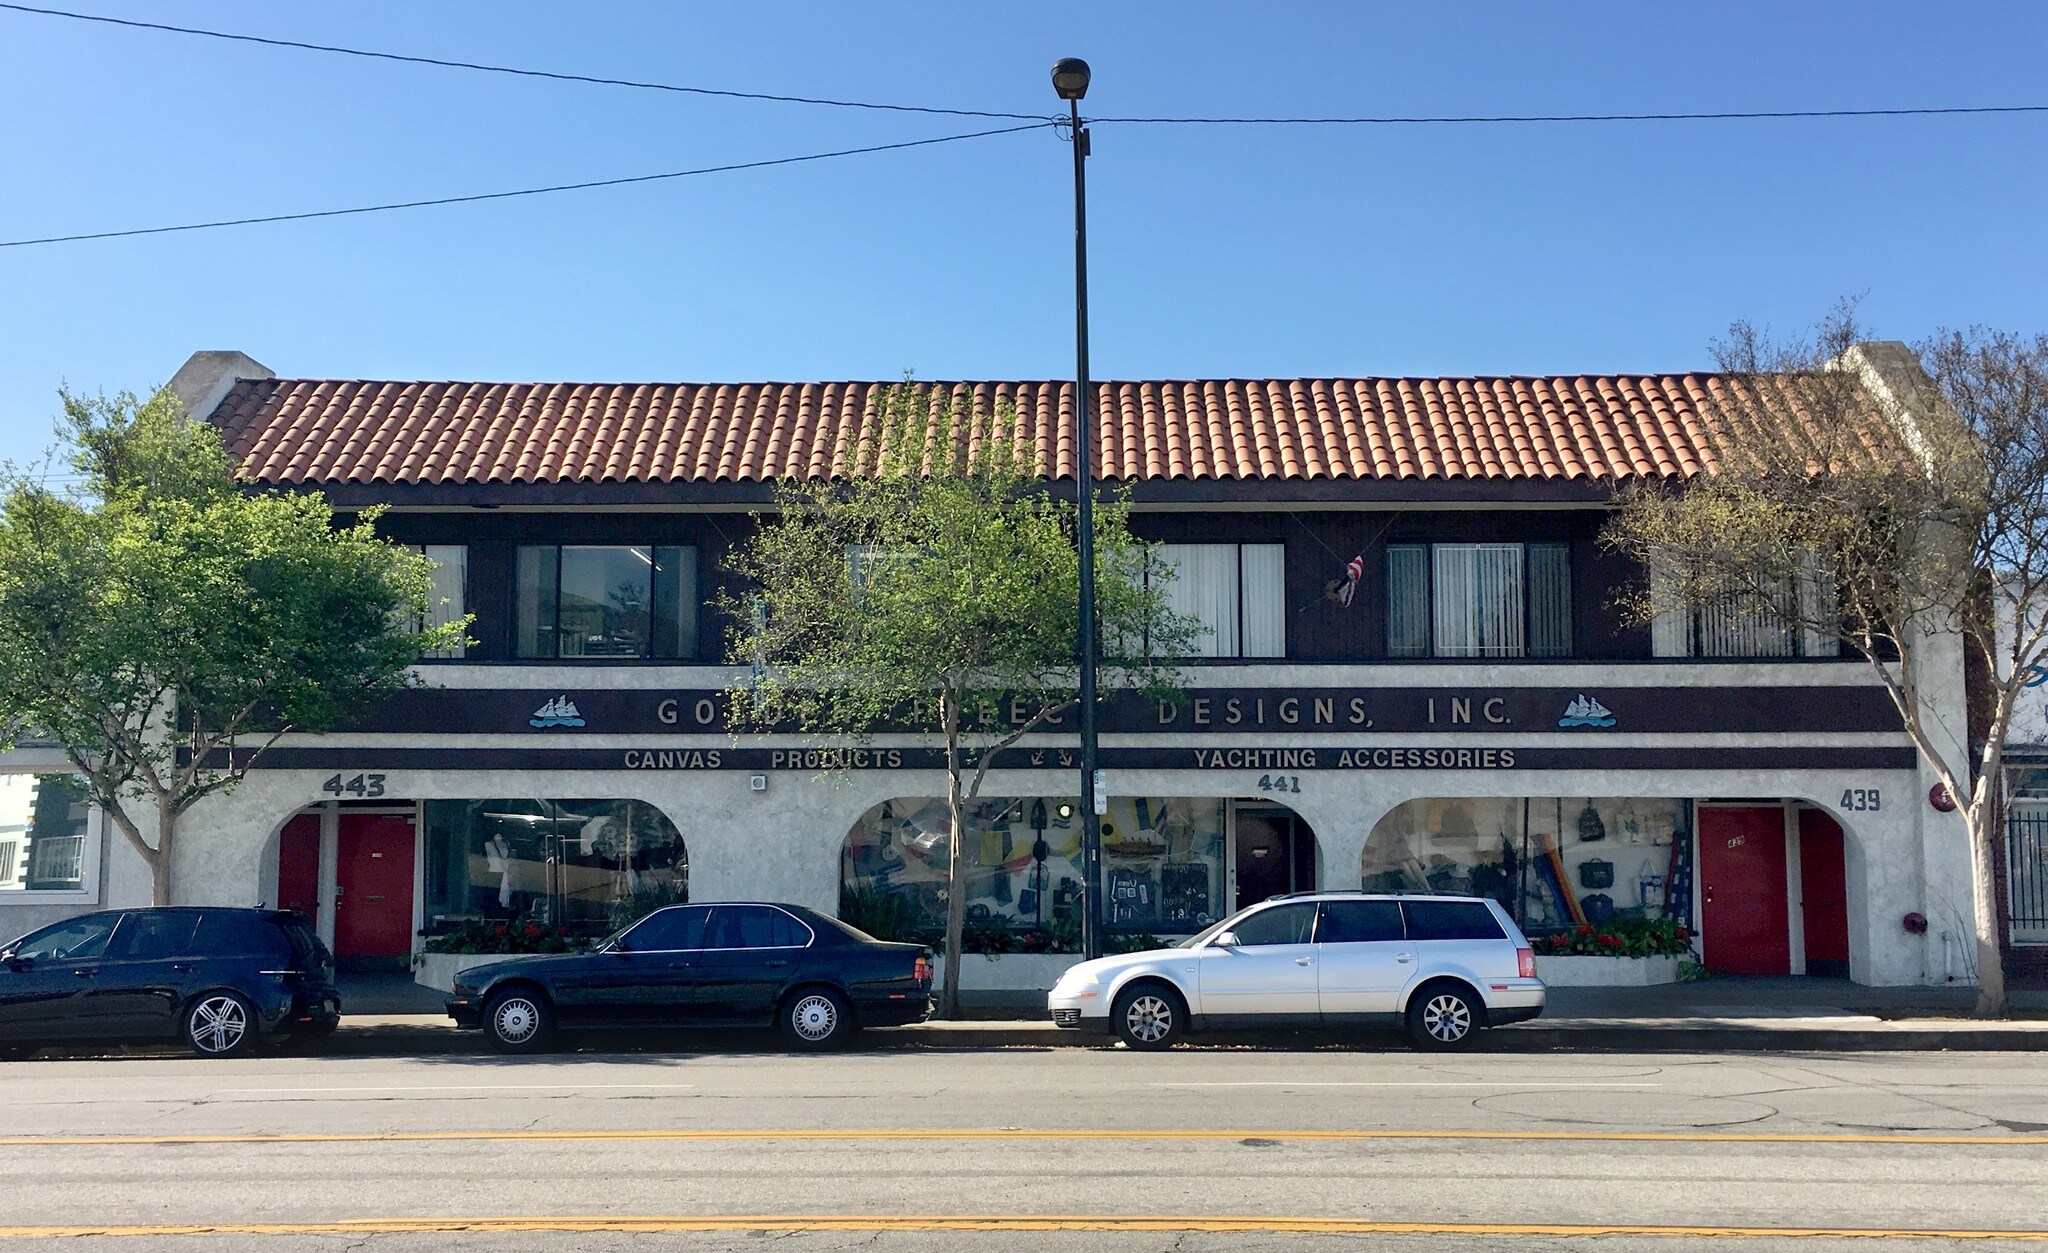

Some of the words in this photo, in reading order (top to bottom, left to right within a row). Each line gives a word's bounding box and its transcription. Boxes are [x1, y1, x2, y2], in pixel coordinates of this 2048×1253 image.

[1158, 698, 1374, 728] DESIGNS,
[1428, 698, 1511, 724] INC.
[624, 750, 721, 769] CANVAS
[771, 750, 902, 769] PRODUCTS
[1194, 750, 1316, 769] YACHTING
[1338, 750, 1515, 769] ACCESSORIES
[323, 773, 386, 797] 443
[1258, 774, 1301, 793] 441
[1840, 789, 1881, 811] 439
